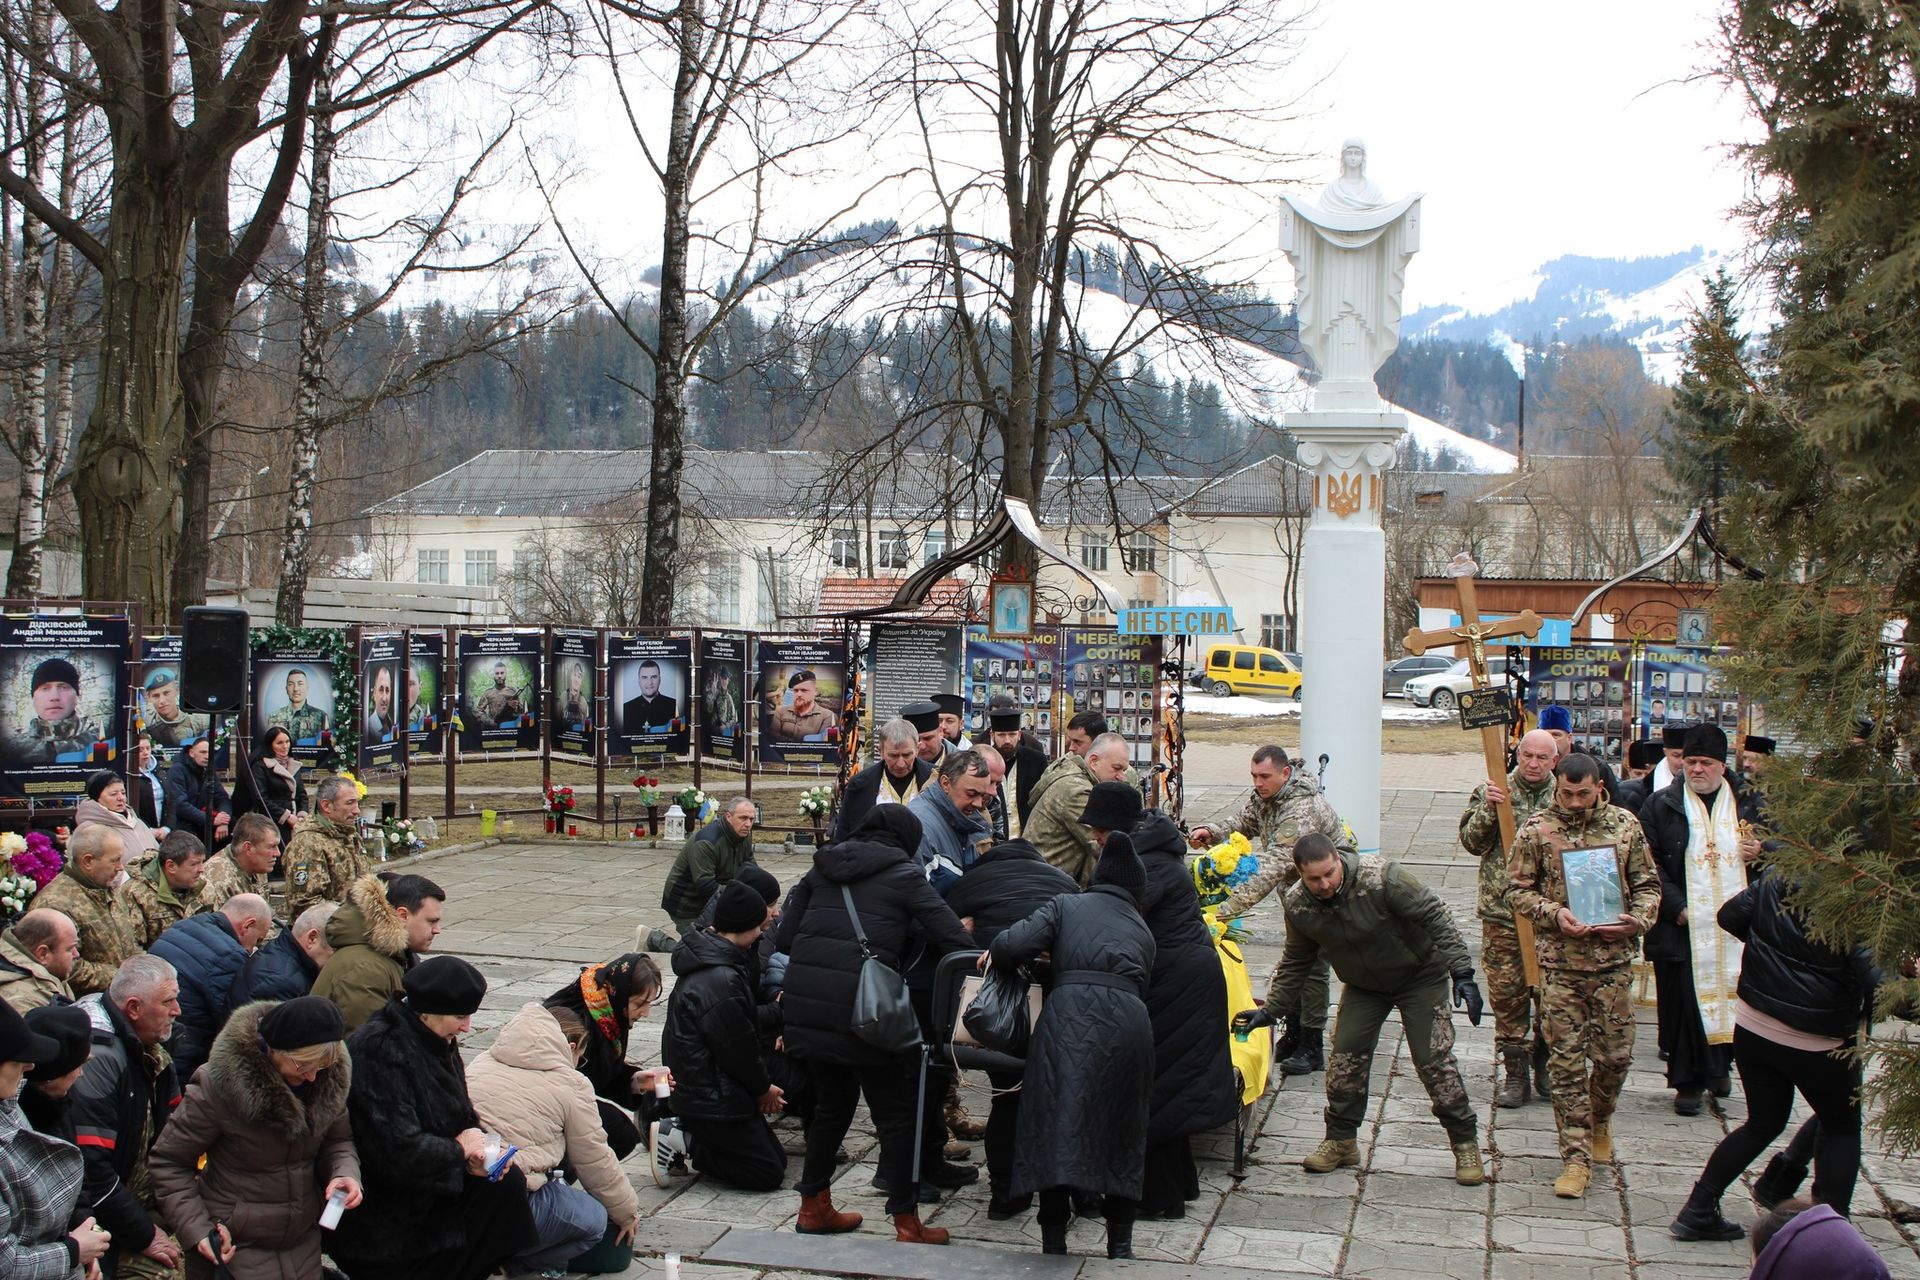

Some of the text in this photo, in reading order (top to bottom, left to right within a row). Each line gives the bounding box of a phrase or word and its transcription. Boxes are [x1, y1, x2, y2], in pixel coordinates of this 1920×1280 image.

[29, 620, 88, 629] ДІДКІВСЬКИЙ
[1126, 611, 1229, 633] НЕБЕСНА
[12, 628, 104, 636] Андрій Миколайович
[919, 628, 947, 637] Україну
[1075, 633, 1153, 646] НЕБЕСНА
[1086, 647, 1141, 661] СОТНЯ
[1539, 648, 1622, 662] НЕБЕСНА
[1550, 663, 1610, 677] СОТНЯ
